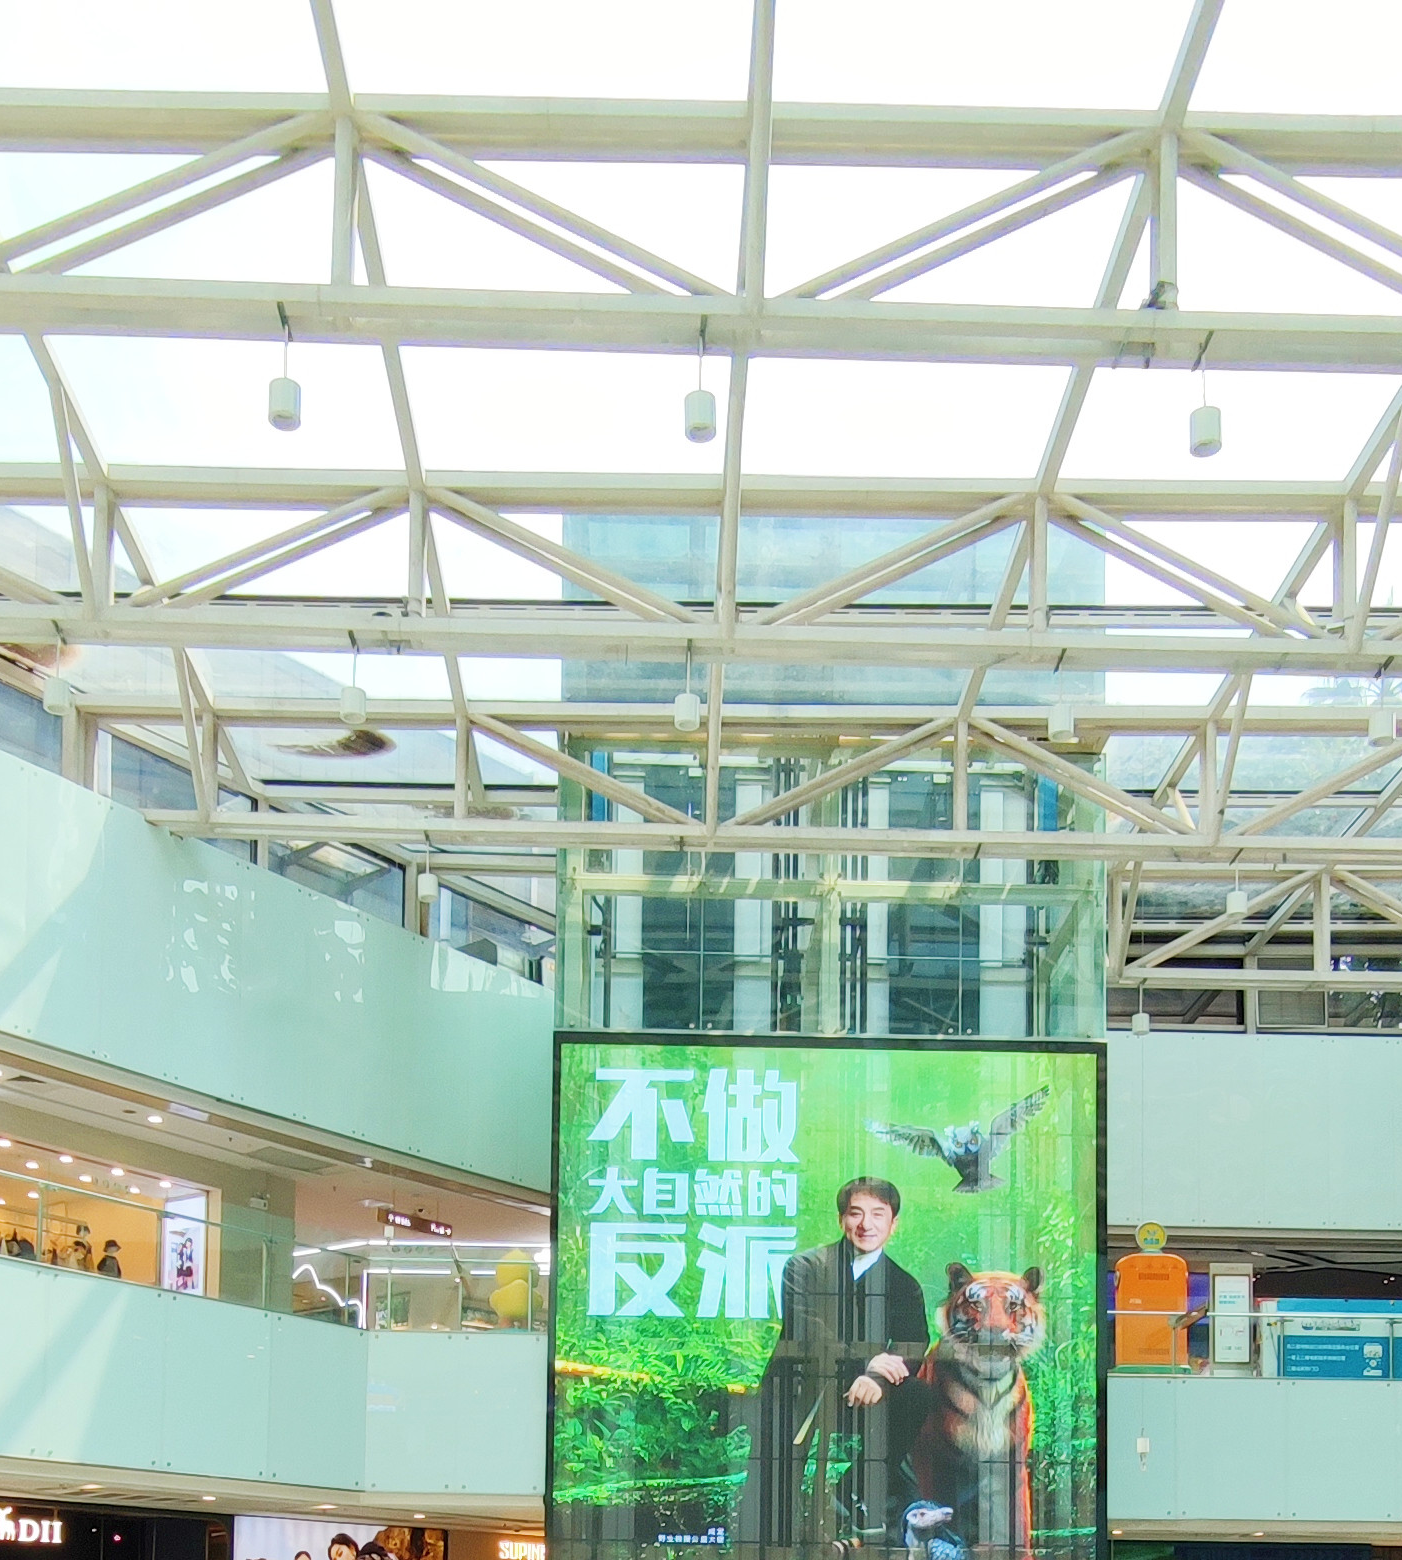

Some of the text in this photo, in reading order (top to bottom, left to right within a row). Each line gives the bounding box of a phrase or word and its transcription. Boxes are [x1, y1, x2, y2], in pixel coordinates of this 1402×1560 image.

[587, 1068, 800, 1163] 不做
[587, 1168, 798, 1216] 大自然的
[587, 1222, 798, 1319] 反派
